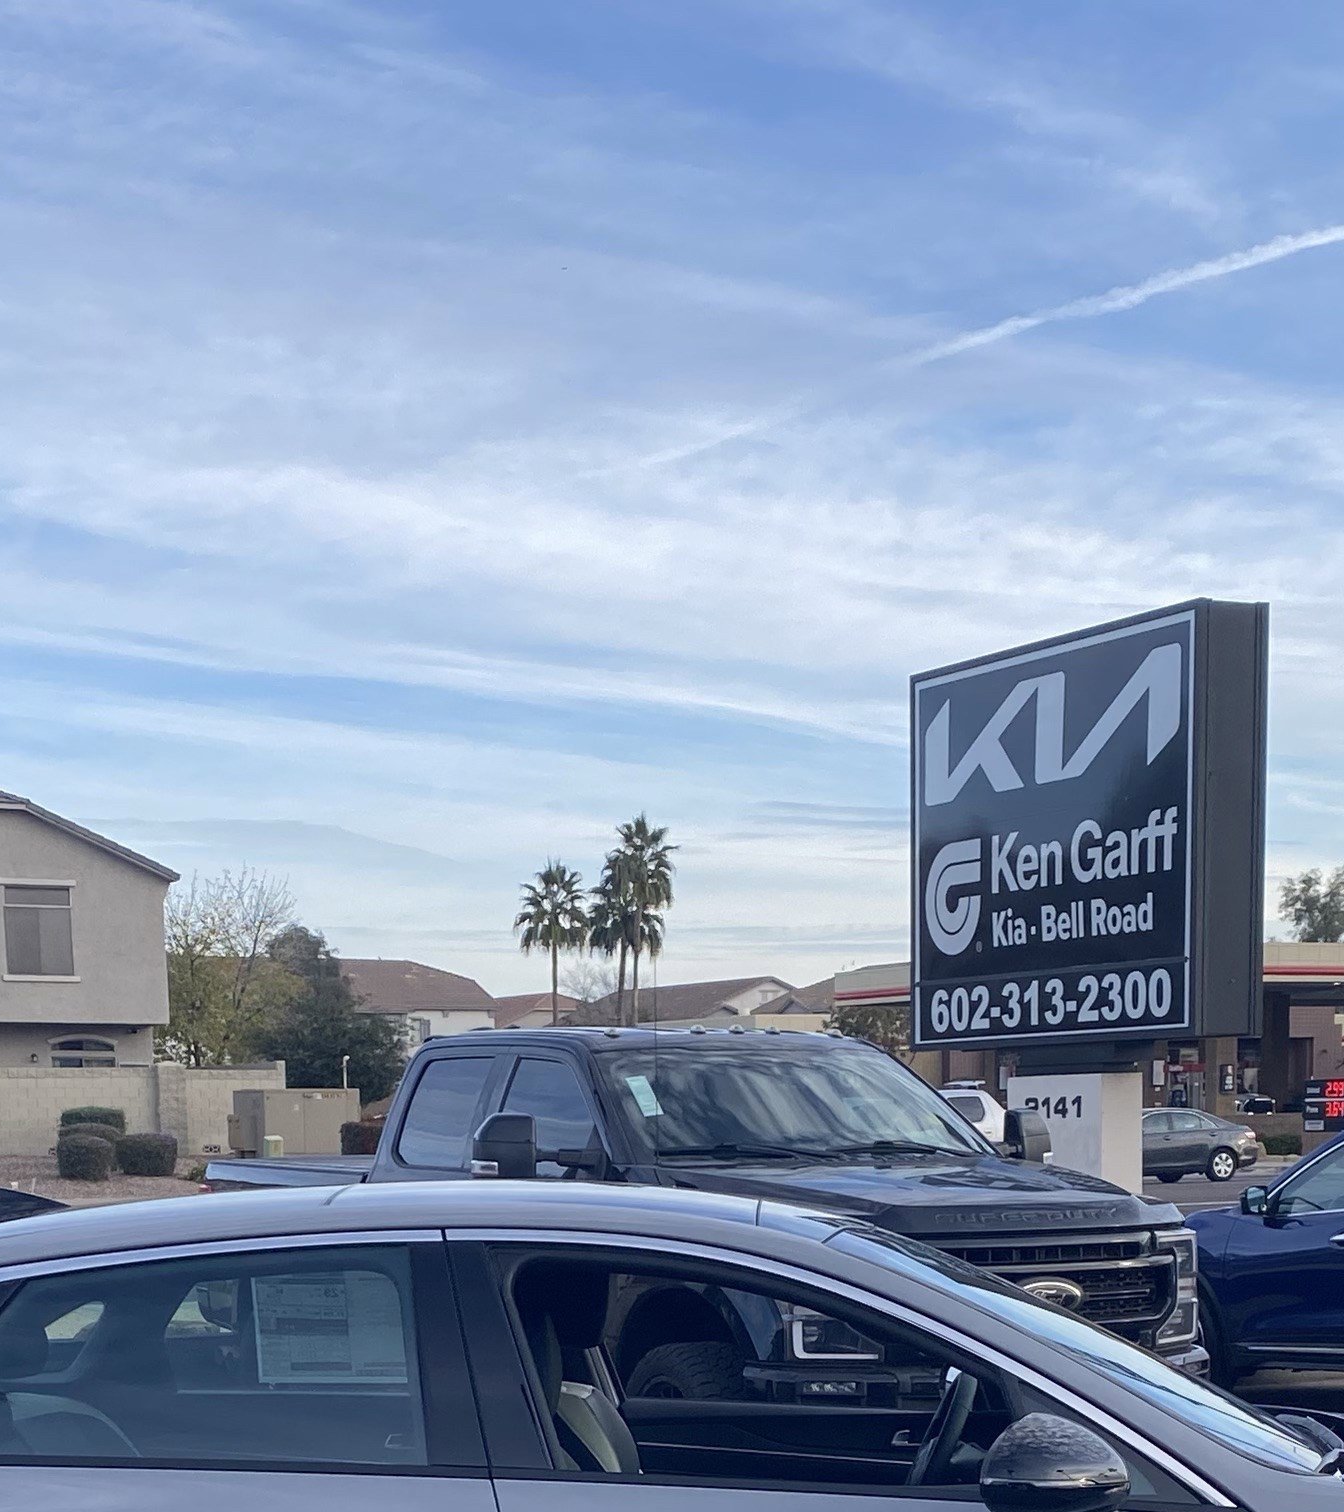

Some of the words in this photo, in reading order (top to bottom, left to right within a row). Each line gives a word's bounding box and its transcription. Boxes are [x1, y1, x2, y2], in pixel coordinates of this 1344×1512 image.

[925, 642, 1182, 807] KIA
[990, 832, 1063, 894] Ken
[1070, 806, 1178, 884] Garff
[992, 908, 1028, 948] Kia
[1041, 900, 1084, 942] Bell
[1091, 893, 1154, 936] Road
[930, 968, 1172, 1033] 602-313-2300
[1025, 1095, 1082, 1119] 2141
